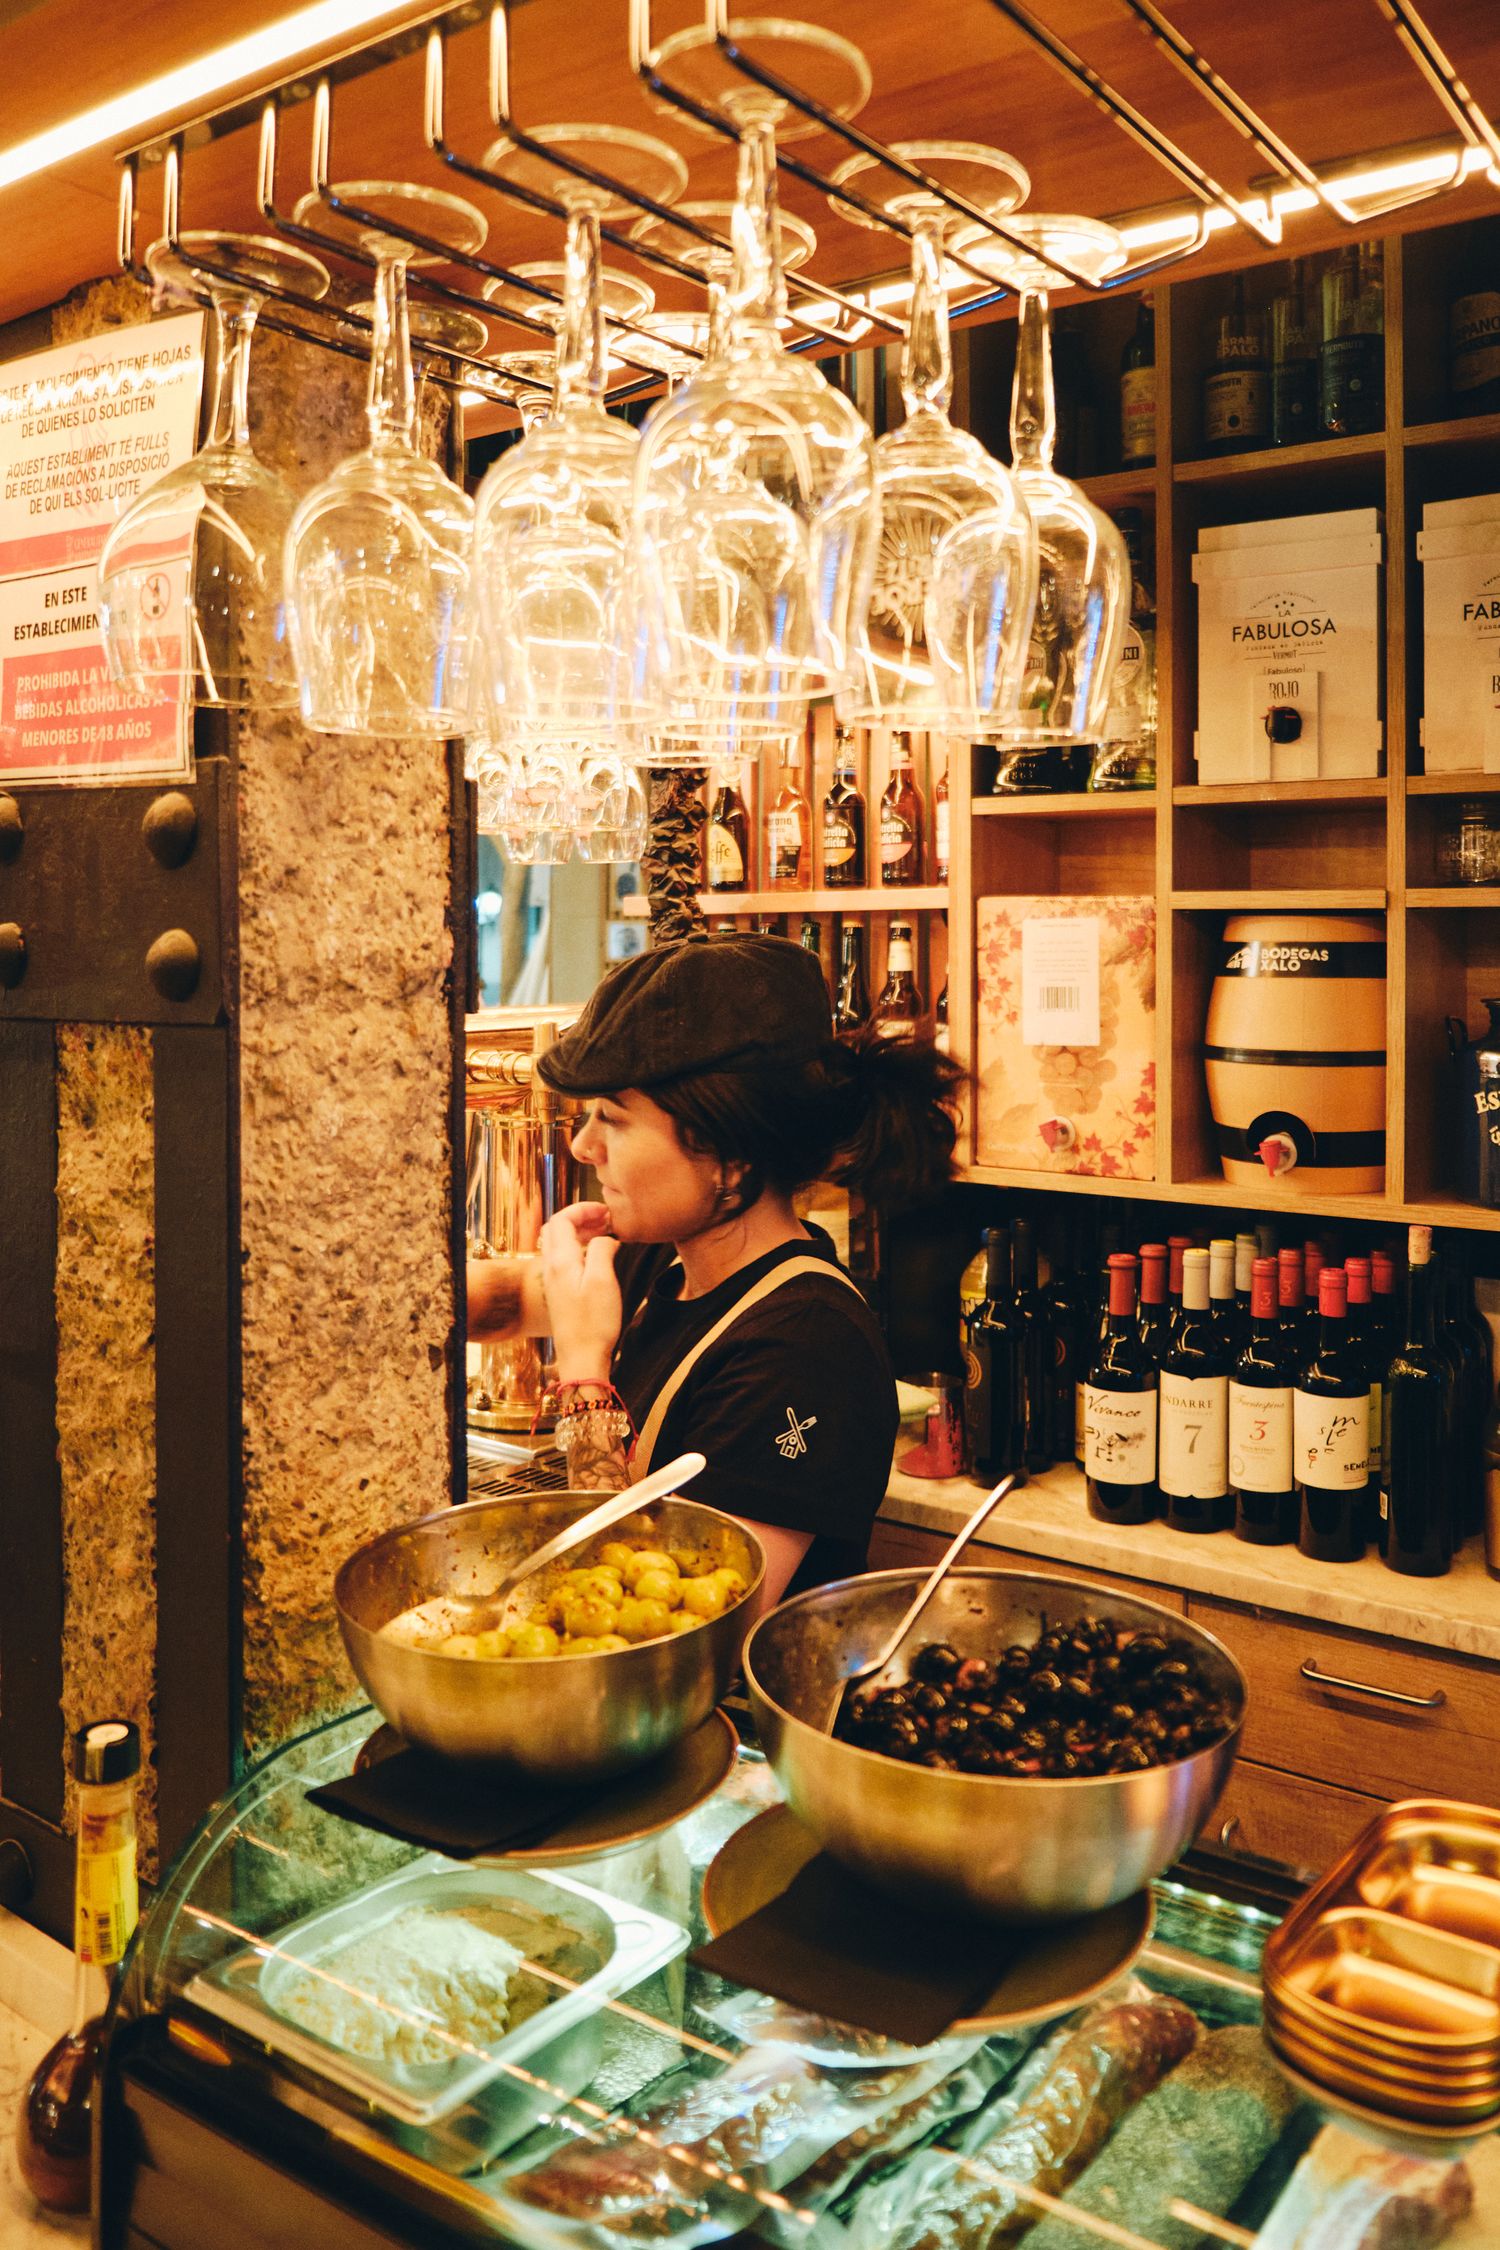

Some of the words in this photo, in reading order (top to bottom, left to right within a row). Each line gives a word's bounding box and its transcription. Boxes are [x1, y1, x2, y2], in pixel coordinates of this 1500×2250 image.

[153, 345, 191, 368] HOJAS
[21, 422, 34, 439] DE
[36, 411, 80, 434] QUIENES
[83, 407, 97, 424] LO
[99, 394, 155, 420] SOLICITEN
[7, 457, 45, 479] AQUEST
[47, 442, 116, 471] ESTABLIMENT
[134, 432, 170, 453] FULLS
[5, 483, 18, 499] DE
[98, 465, 106, 481] A
[30, 499, 42, 515] DE
[44, 496, 61, 512] QUI
[64, 490, 82, 508] ELS
[45, 593, 59, 608] EN
[62, 586, 87, 604] ESTE
[1463, 601, 1500, 622] FAB
[1232, 618, 1337, 642] FABULOSA
[17, 669, 80, 693] PROHIBIDA
[82, 667, 98, 685] LA
[15, 700, 63, 721] BEBIDAS
[22, 728, 79, 748] MENORES
[81, 726, 97, 744] DE
[98, 724, 114, 741] 18
[116, 715, 152, 740] AÑOS
[1261, 947, 1329, 961] BODEGAS
[1163, 1395, 1214, 1409] NDARRE
[1183, 1424, 1203, 1454] 7
[1249, 1420, 1269, 1441] 3
